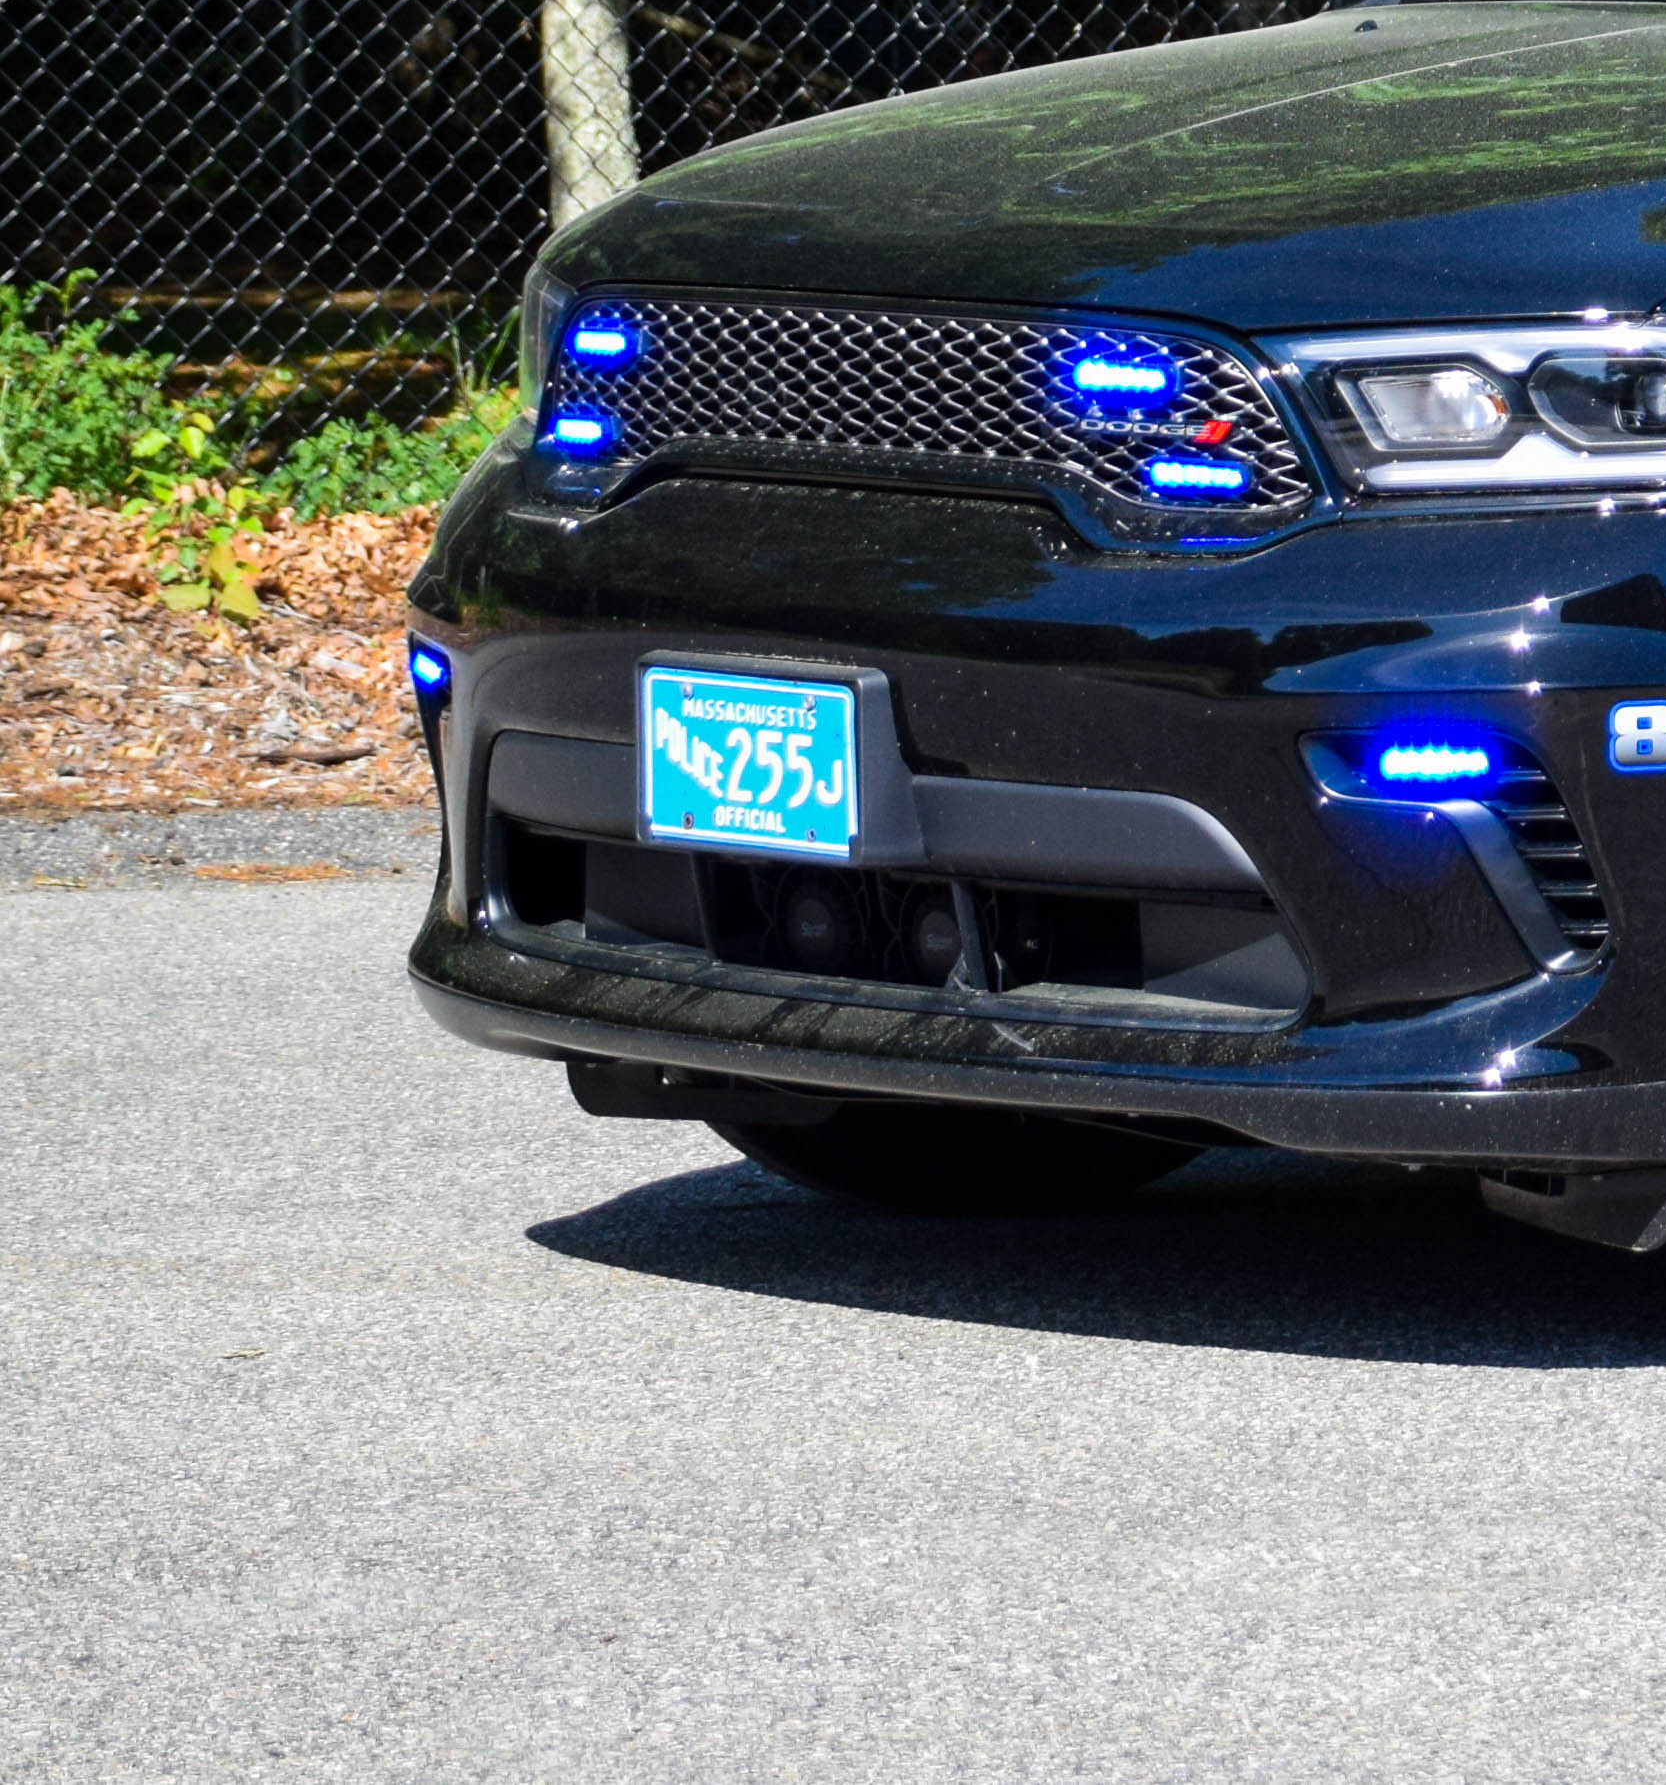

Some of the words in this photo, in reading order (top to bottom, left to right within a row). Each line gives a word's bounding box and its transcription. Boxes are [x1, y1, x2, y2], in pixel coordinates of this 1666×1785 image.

[1080, 418, 1211, 437] DODGE
[682, 697, 816, 730] MASSACHUSETTS
[654, 707, 724, 799] POLICE
[713, 805, 786, 833] OFFICIAL
